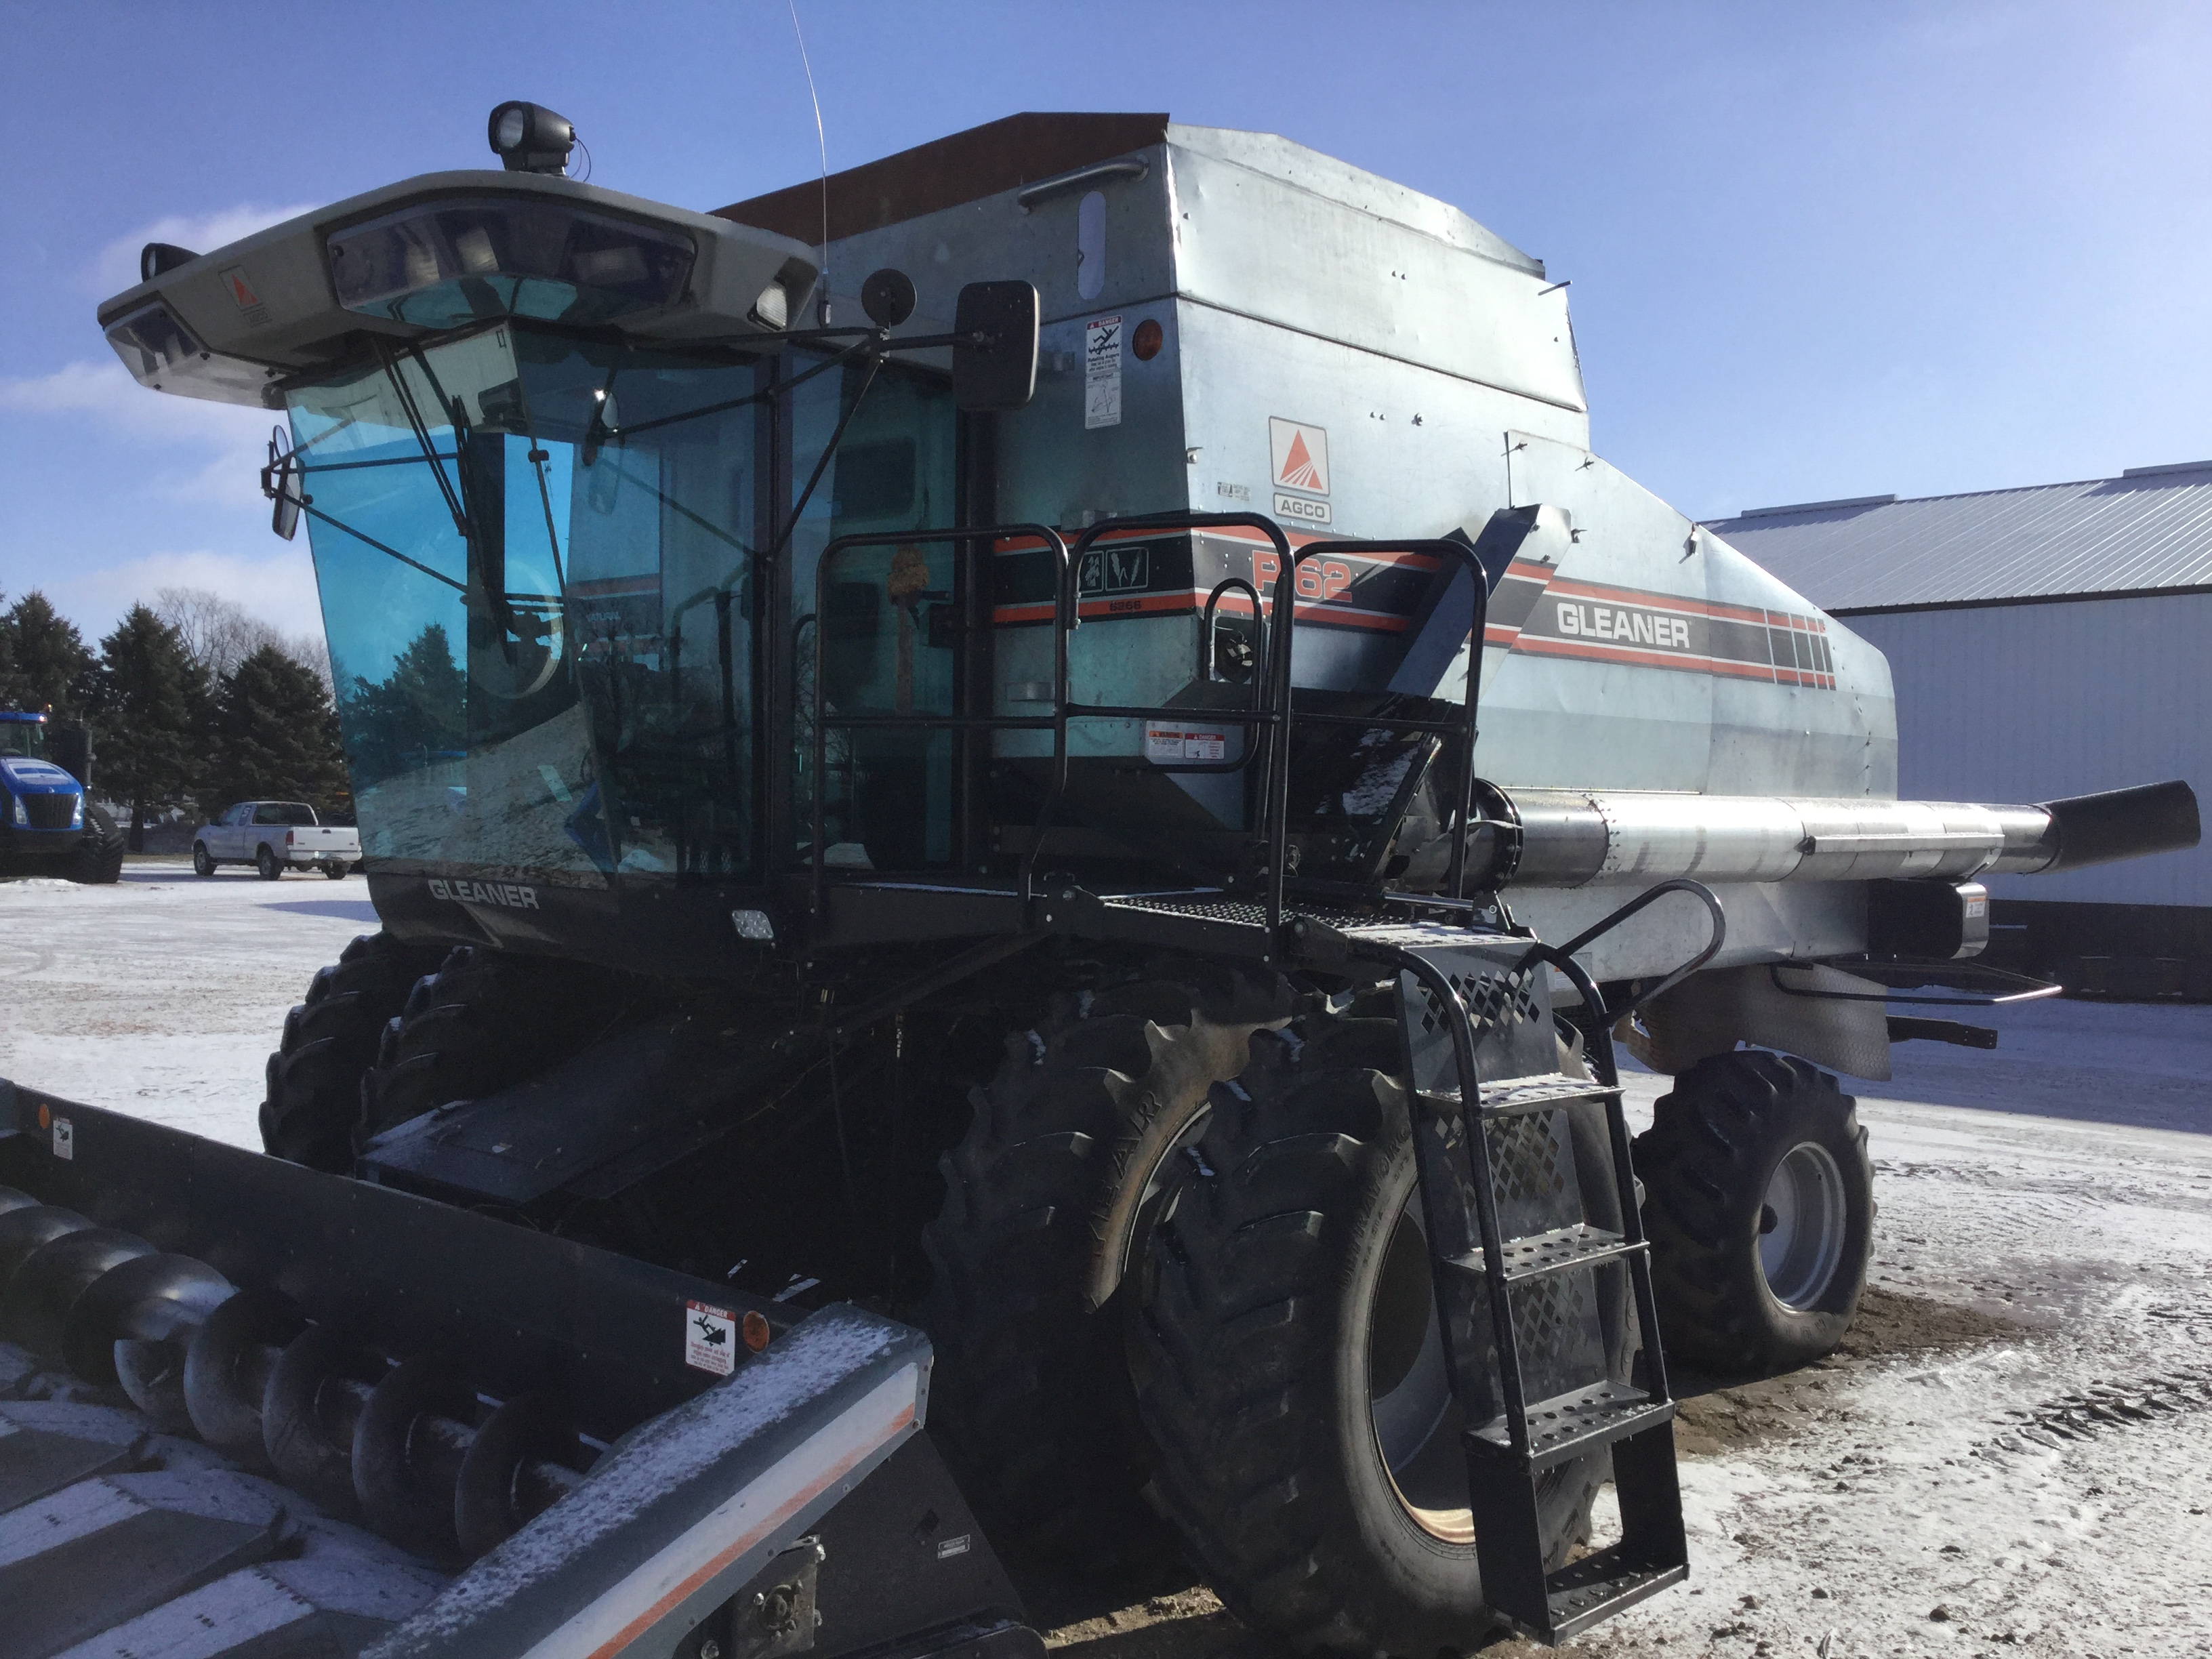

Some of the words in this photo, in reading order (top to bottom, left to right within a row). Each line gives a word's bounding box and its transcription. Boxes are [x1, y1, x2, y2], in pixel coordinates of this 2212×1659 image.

[1098, 316, 1119, 326] DANGER
[1281, 499, 1325, 518] AGCO
[1557, 602, 1690, 649] GLEANER
[428, 879, 540, 909] GLEANER
[704, 1305, 729, 1319] DANGER
